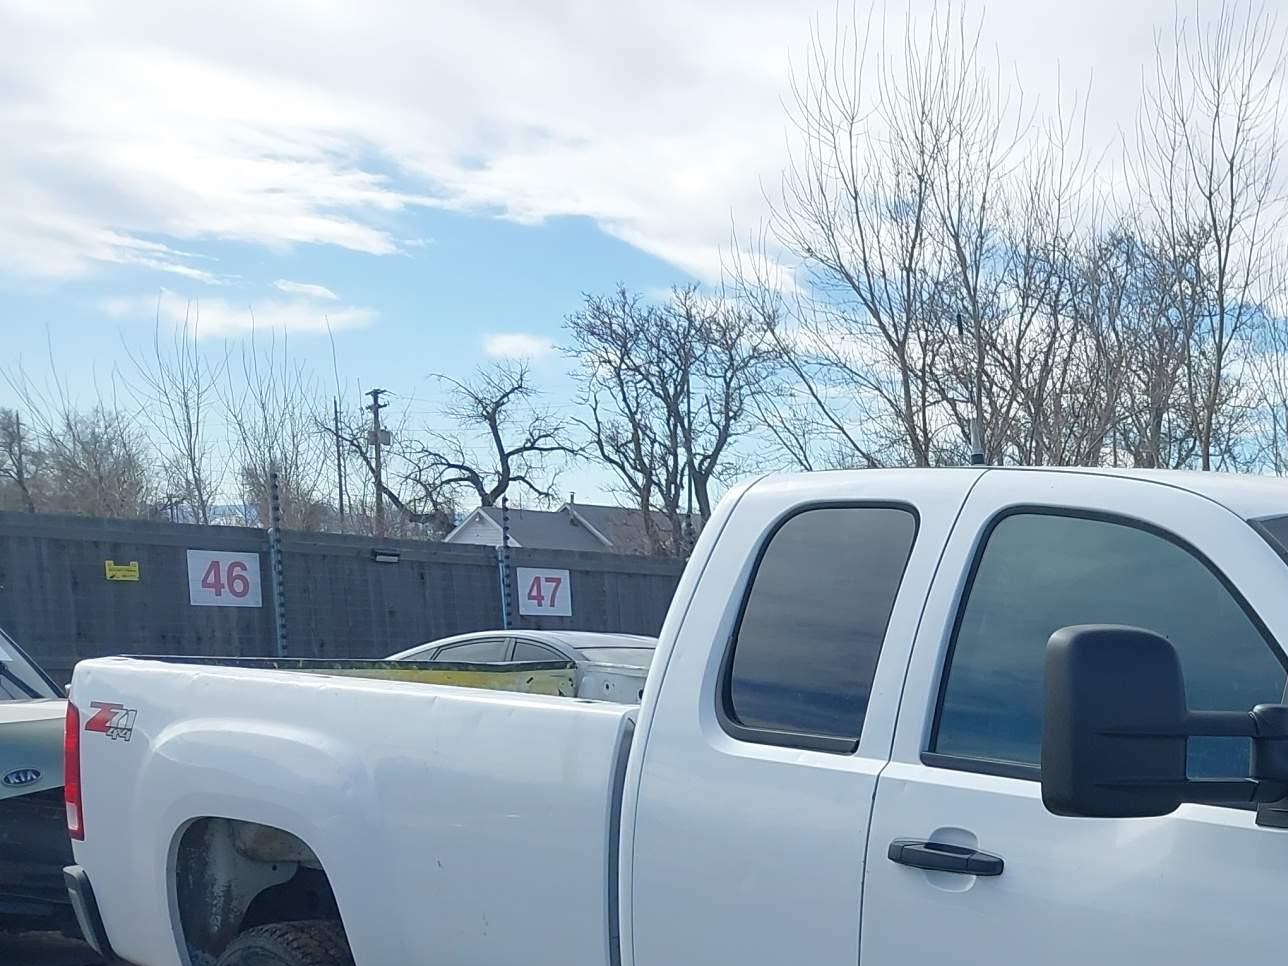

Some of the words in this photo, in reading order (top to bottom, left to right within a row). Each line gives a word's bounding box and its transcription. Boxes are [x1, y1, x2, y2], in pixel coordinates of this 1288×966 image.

[200, 560, 250, 599] 46
[527, 575, 563, 608] 47
[85, 701, 138, 733] Z71
[7, 770, 38, 784] KIA
